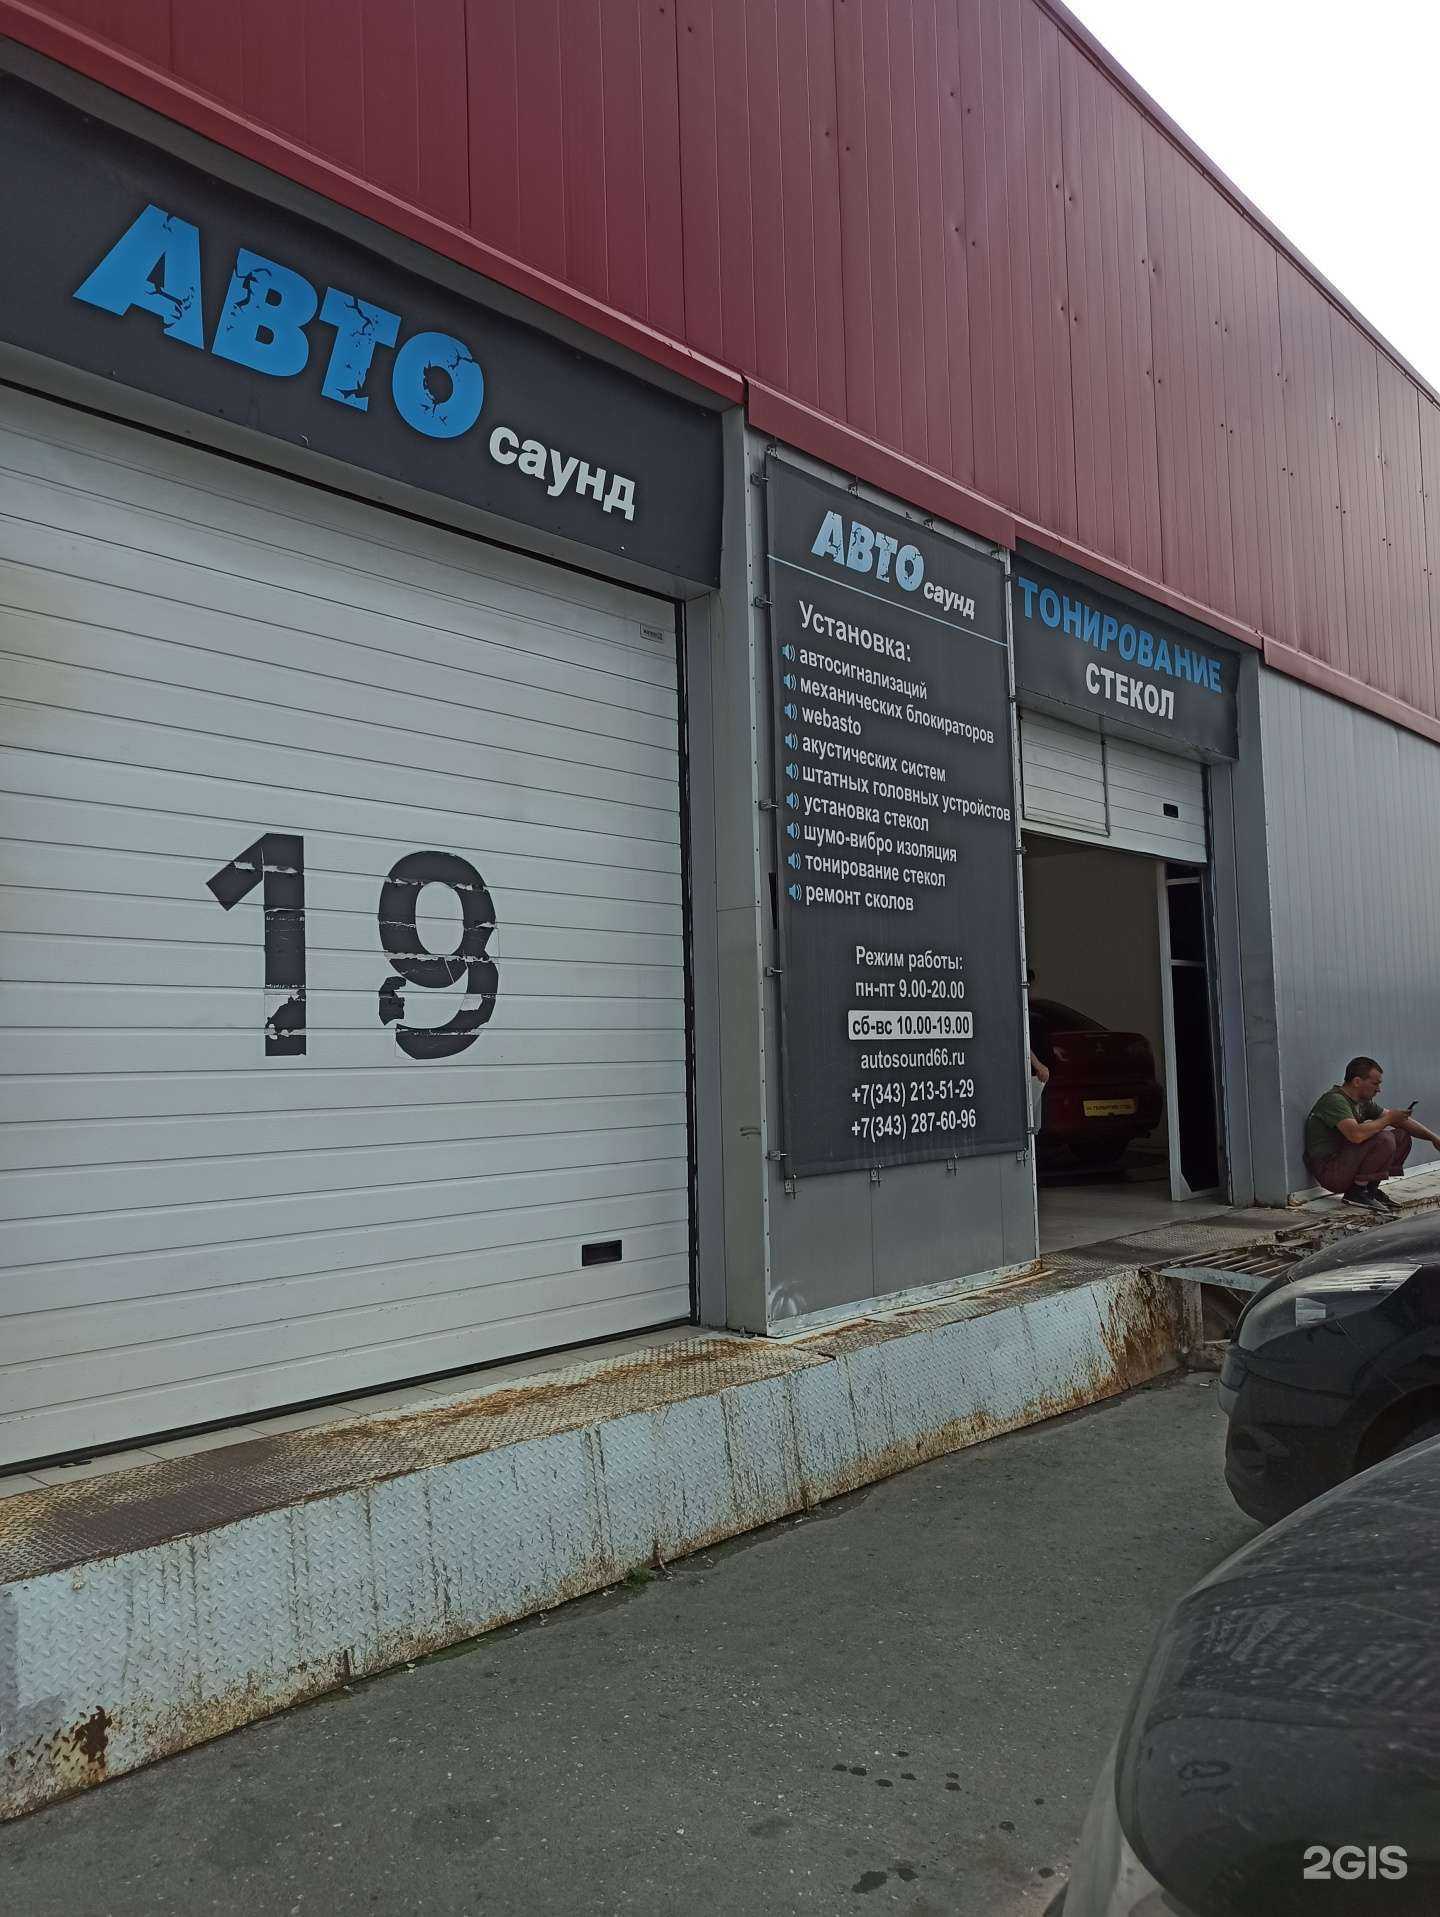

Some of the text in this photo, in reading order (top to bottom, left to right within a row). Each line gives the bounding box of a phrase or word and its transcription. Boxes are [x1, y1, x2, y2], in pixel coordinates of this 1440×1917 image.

[72, 203, 636, 522] АВТО саунд
[810, 510, 976, 620] АВТО саунд
[798, 599, 912, 662] Установка:
[1017, 575, 1224, 694] ТОНИРОВАНИЕ
[799, 646, 928, 700] автосигнализаций
[1084, 662, 1176, 721] СТЕКОЛ
[800, 677, 994, 744] механических блокираторов
[801, 706, 862, 736] webasto
[802, 735, 947, 783] акустических систем
[802, 765, 1011, 822] штатных головных устройстов
[804, 795, 930, 832] установка стекол
[803, 823, 957, 863] шумо-вибро изоляция
[804, 853, 947, 888] тонирование стекол
[805, 884, 915, 912] ремонт сколов
[206, 832, 499, 1060] 19
[855, 945, 964, 973] Режим работы:
[855, 978, 965, 999] пн-пт 9.00-20.00
[852, 1015, 970, 1036] сб-вс 10.00-19.00
[860, 1048, 965, 1069] autosound66.ru
[851, 1078, 975, 1110] +7(343) 213-51-29
[851, 1108, 977, 1143] +7(343) 287-60-96
